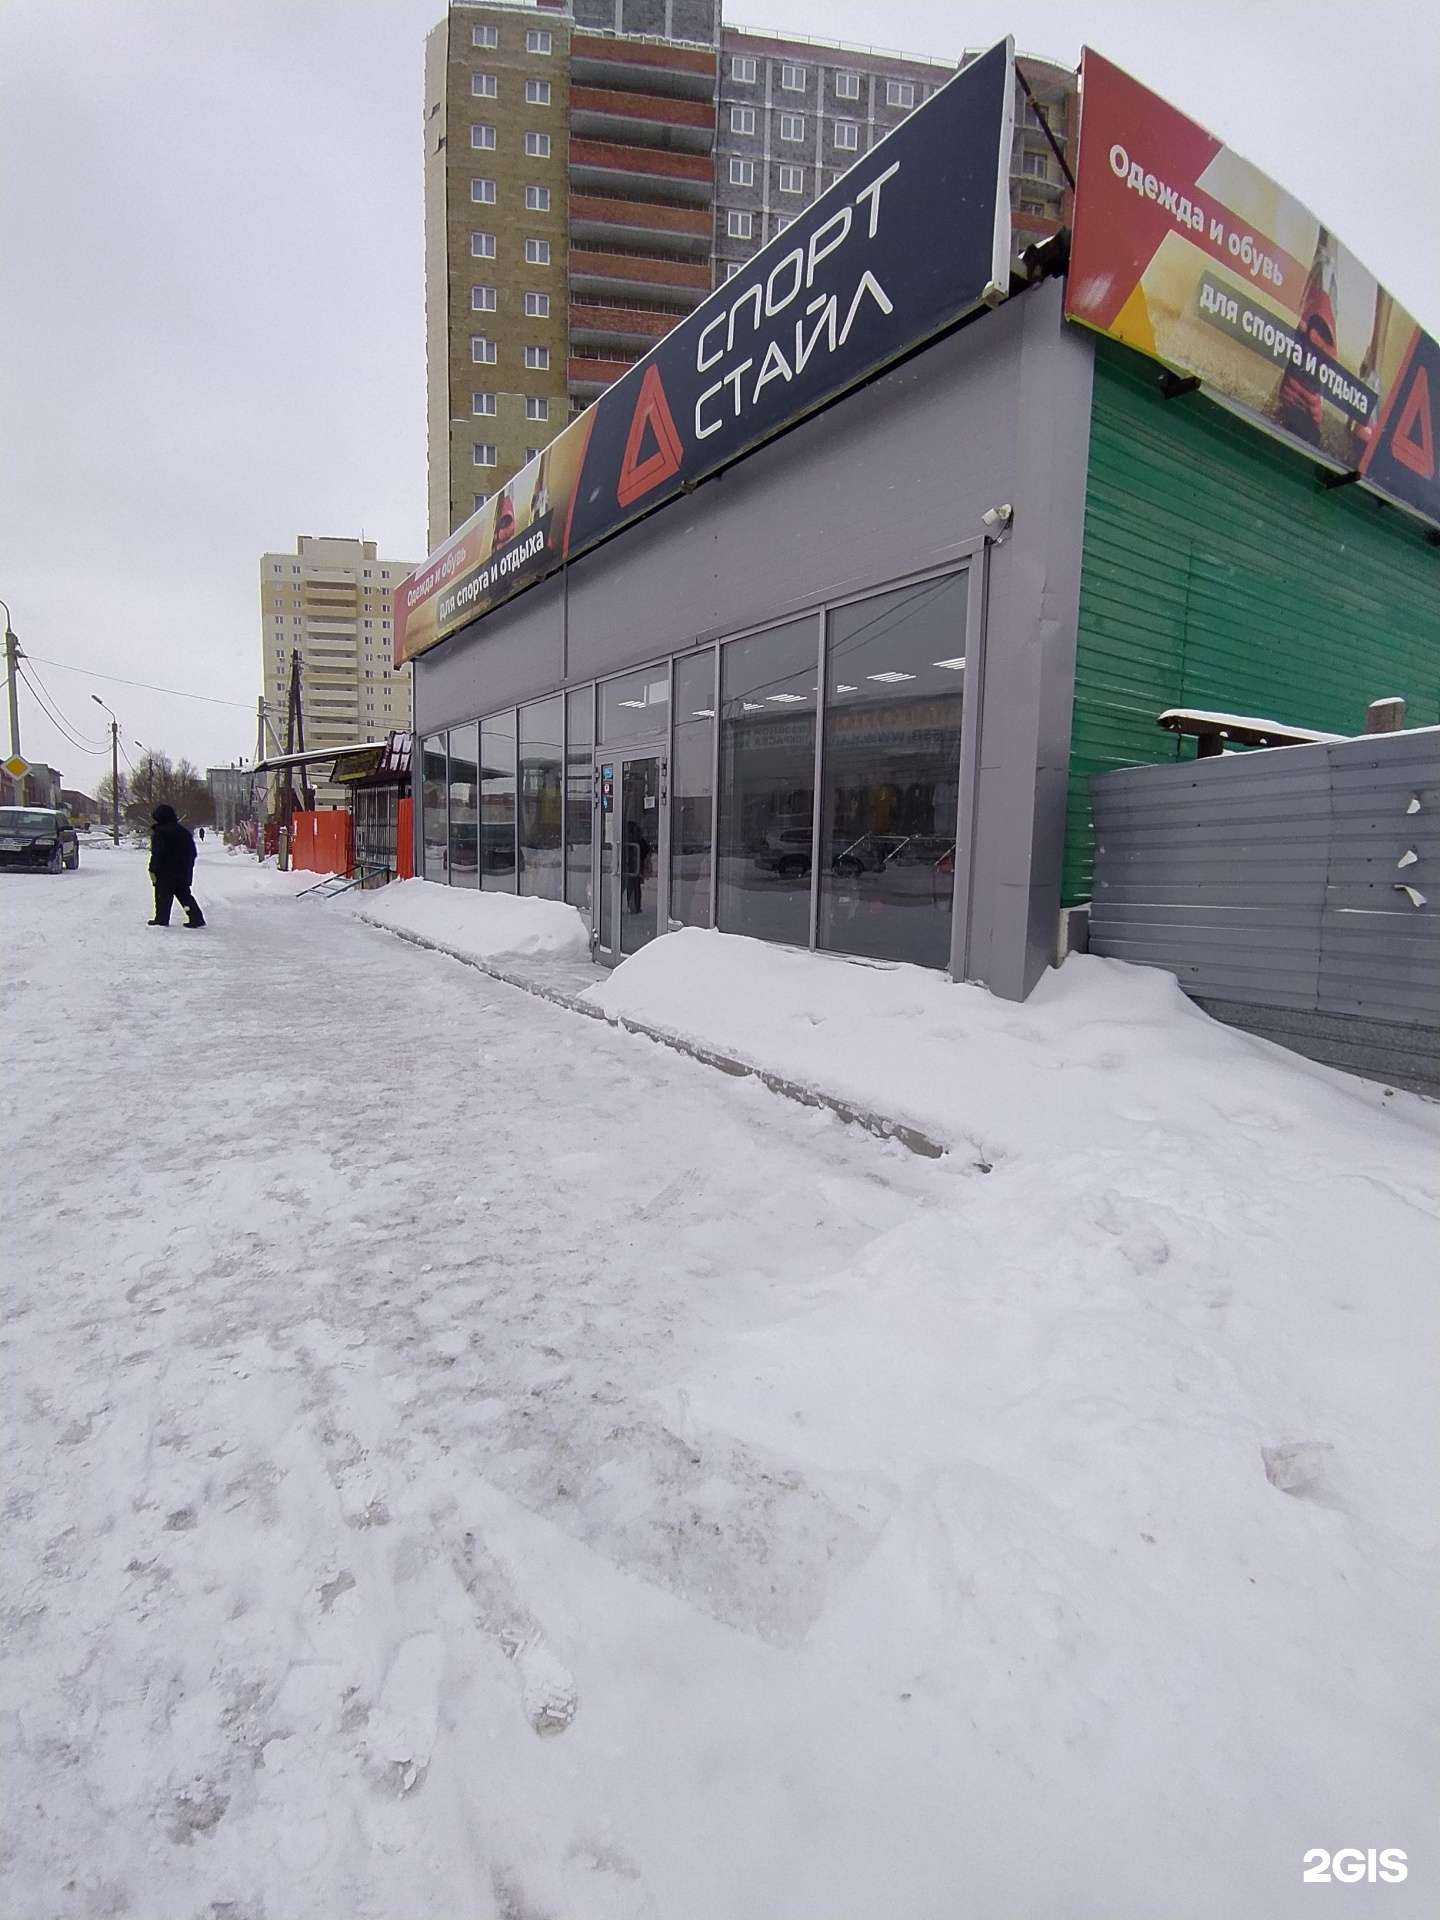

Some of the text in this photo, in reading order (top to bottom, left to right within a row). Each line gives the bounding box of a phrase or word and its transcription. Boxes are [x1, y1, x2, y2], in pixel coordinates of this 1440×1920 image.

[695, 161, 901, 373] СПОРТ
[1109, 144, 1284, 287] Одежда и обувь
[694, 270, 894, 440] СТАЙЛ
[1200, 284, 1369, 414] для спорта и отдыха
[439, 530, 544, 621] для спорта и отдыха
